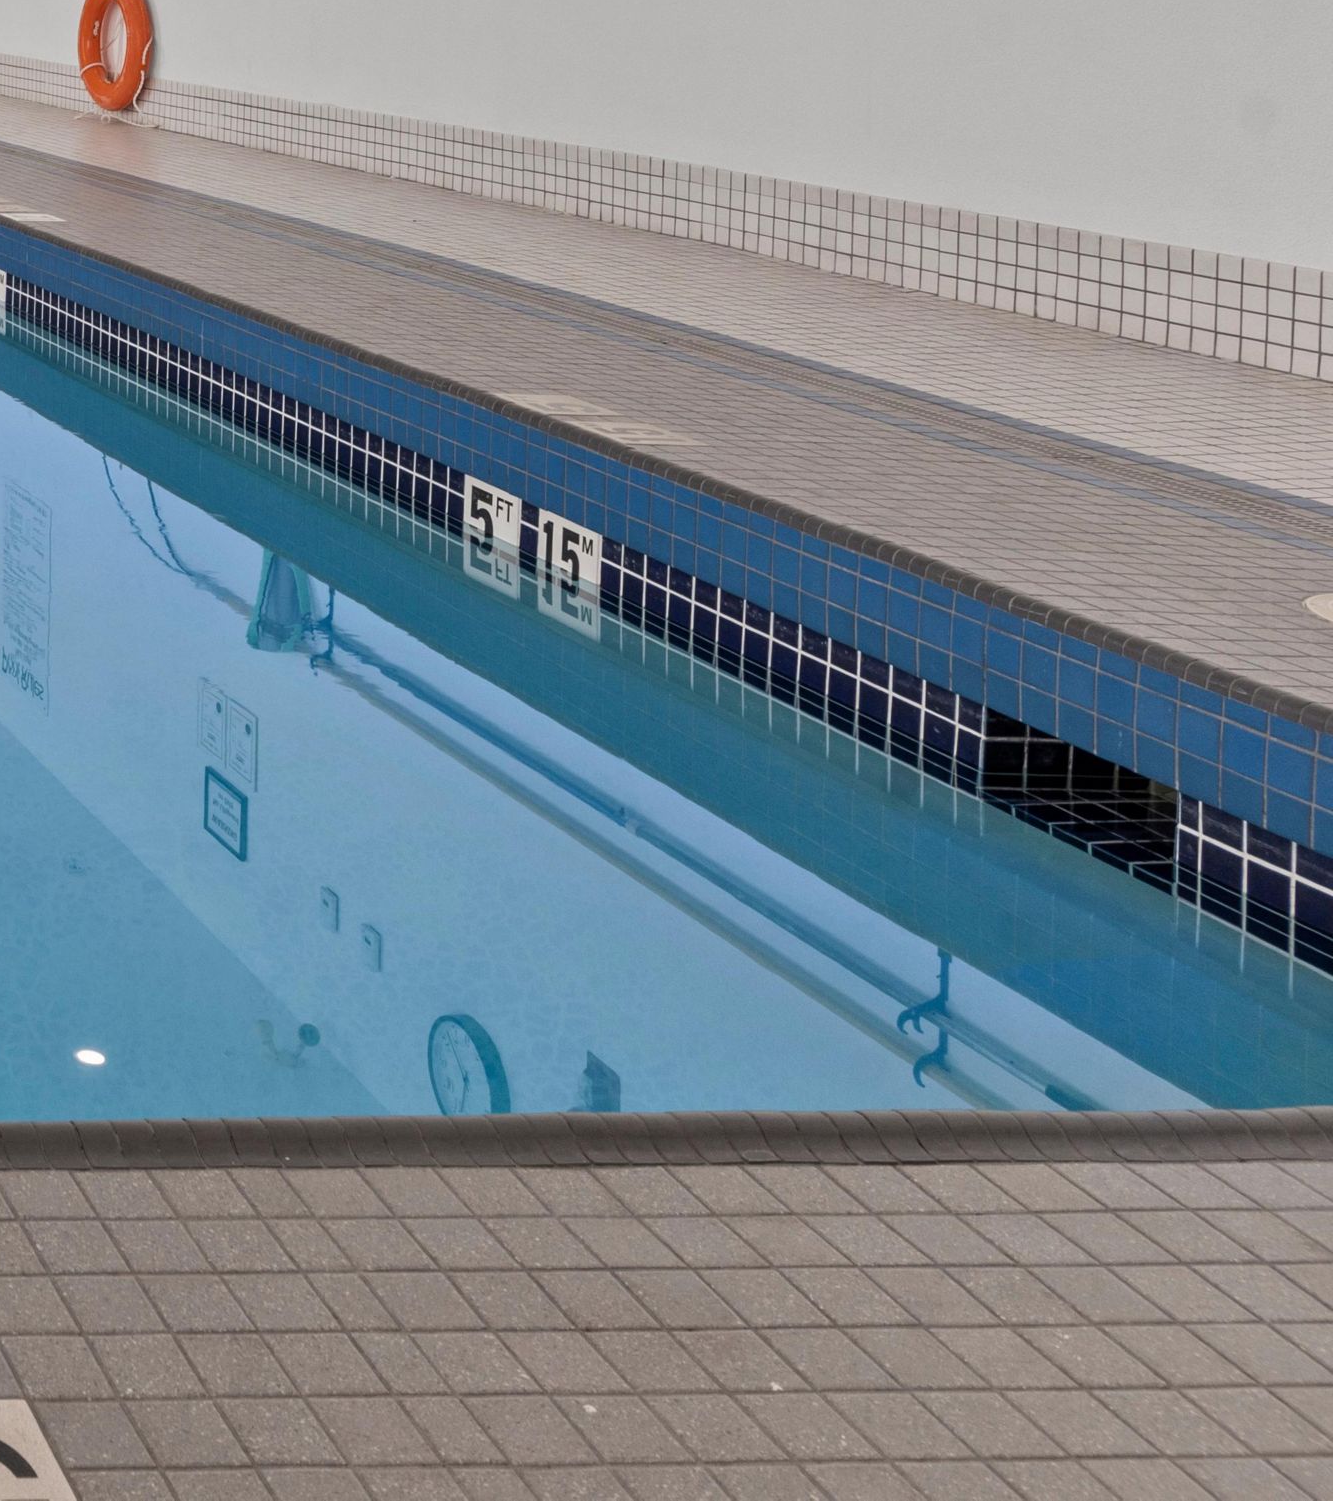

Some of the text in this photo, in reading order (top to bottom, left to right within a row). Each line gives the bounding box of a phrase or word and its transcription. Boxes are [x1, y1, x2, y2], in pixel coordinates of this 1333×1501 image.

[471, 485, 513, 555] 5 FT
[582, 536, 594, 557] M
